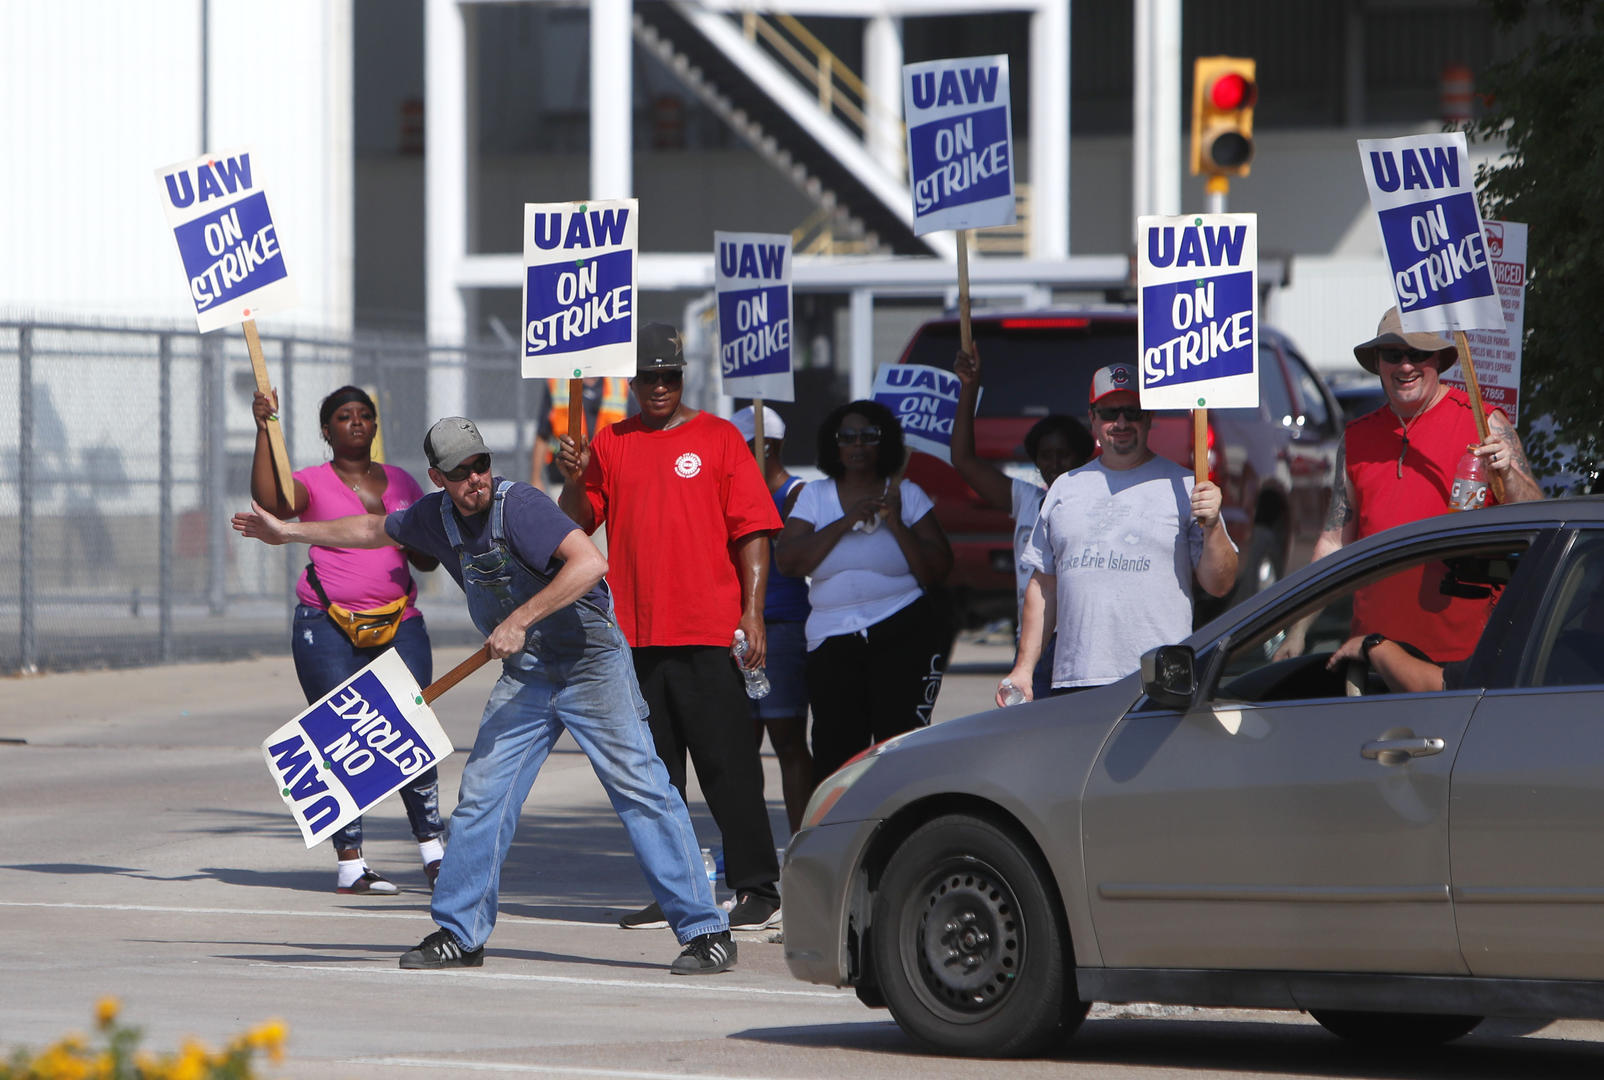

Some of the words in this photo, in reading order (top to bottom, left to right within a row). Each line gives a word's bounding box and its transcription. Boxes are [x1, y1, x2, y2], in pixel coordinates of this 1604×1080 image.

[911, 66, 999, 110] UAW
[935, 116, 973, 162] ON
[164, 152, 252, 208] UAW
[915, 140, 1009, 214] STRIKE
[1369, 146, 1460, 193] UAW
[204, 207, 243, 256] ON
[534, 208, 629, 250] UAW
[1147, 225, 1247, 268] UAW
[1411, 203, 1449, 252] ON
[190, 223, 280, 310] STRIKE
[556, 260, 597, 305] ON
[720, 241, 786, 280] UAW
[1396, 232, 1487, 308] STRIKE
[1493, 263, 1522, 283] ORCED
[526, 285, 631, 352] STRIKE
[736, 291, 768, 332] ON
[1172, 281, 1215, 330] ON
[722, 318, 789, 375] STRIKE
[1144, 310, 1253, 385] STRIKE
[886, 368, 962, 399] UAW
[899, 396, 940, 414] ON
[896, 412, 955, 435] RIK
[1080, 548, 1105, 569] Erie
[1107, 549, 1151, 572] Islands
[327, 685, 431, 776] STRIKE
[323, 731, 376, 777] ON
[267, 734, 341, 836] UAW
